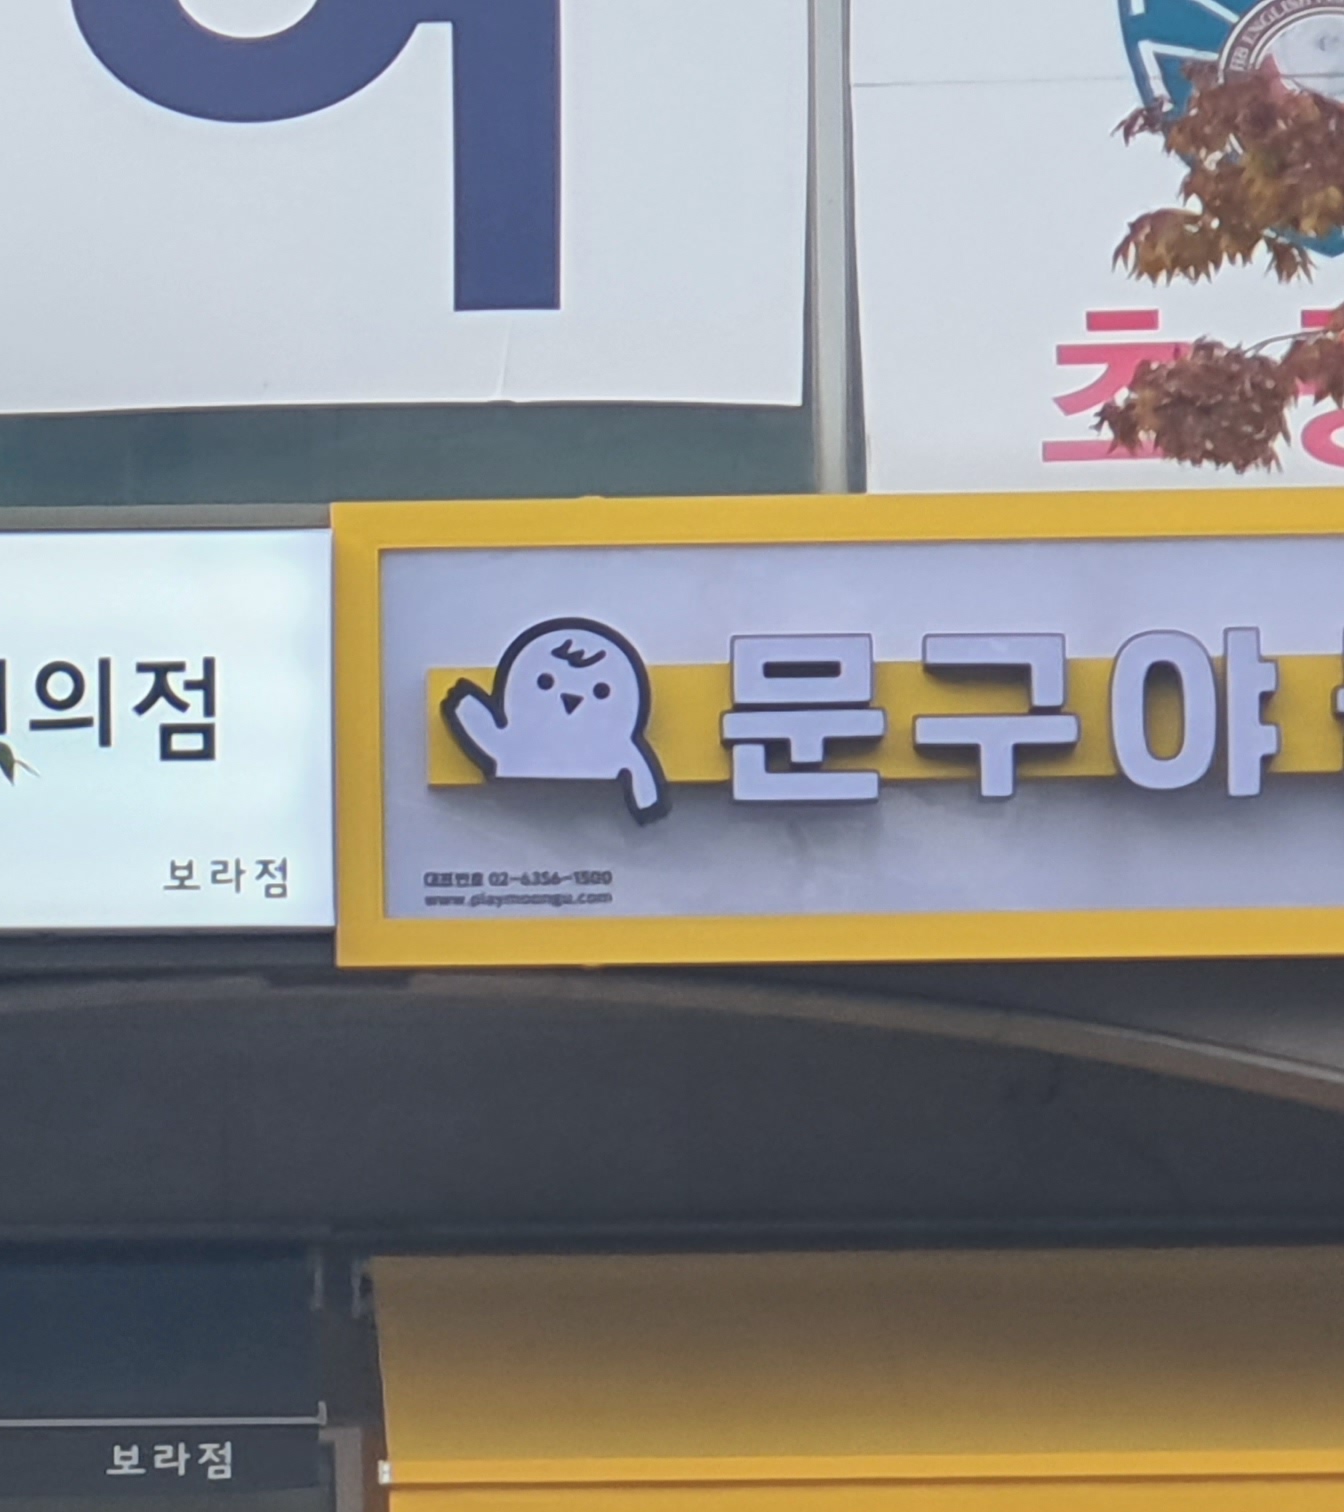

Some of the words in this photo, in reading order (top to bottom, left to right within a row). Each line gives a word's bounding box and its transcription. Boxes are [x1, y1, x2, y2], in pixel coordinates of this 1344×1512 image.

[720, 626, 1280, 801] 문구야
[166, 856, 291, 899] 보라점
[105, 1441, 234, 1480] 보라점
